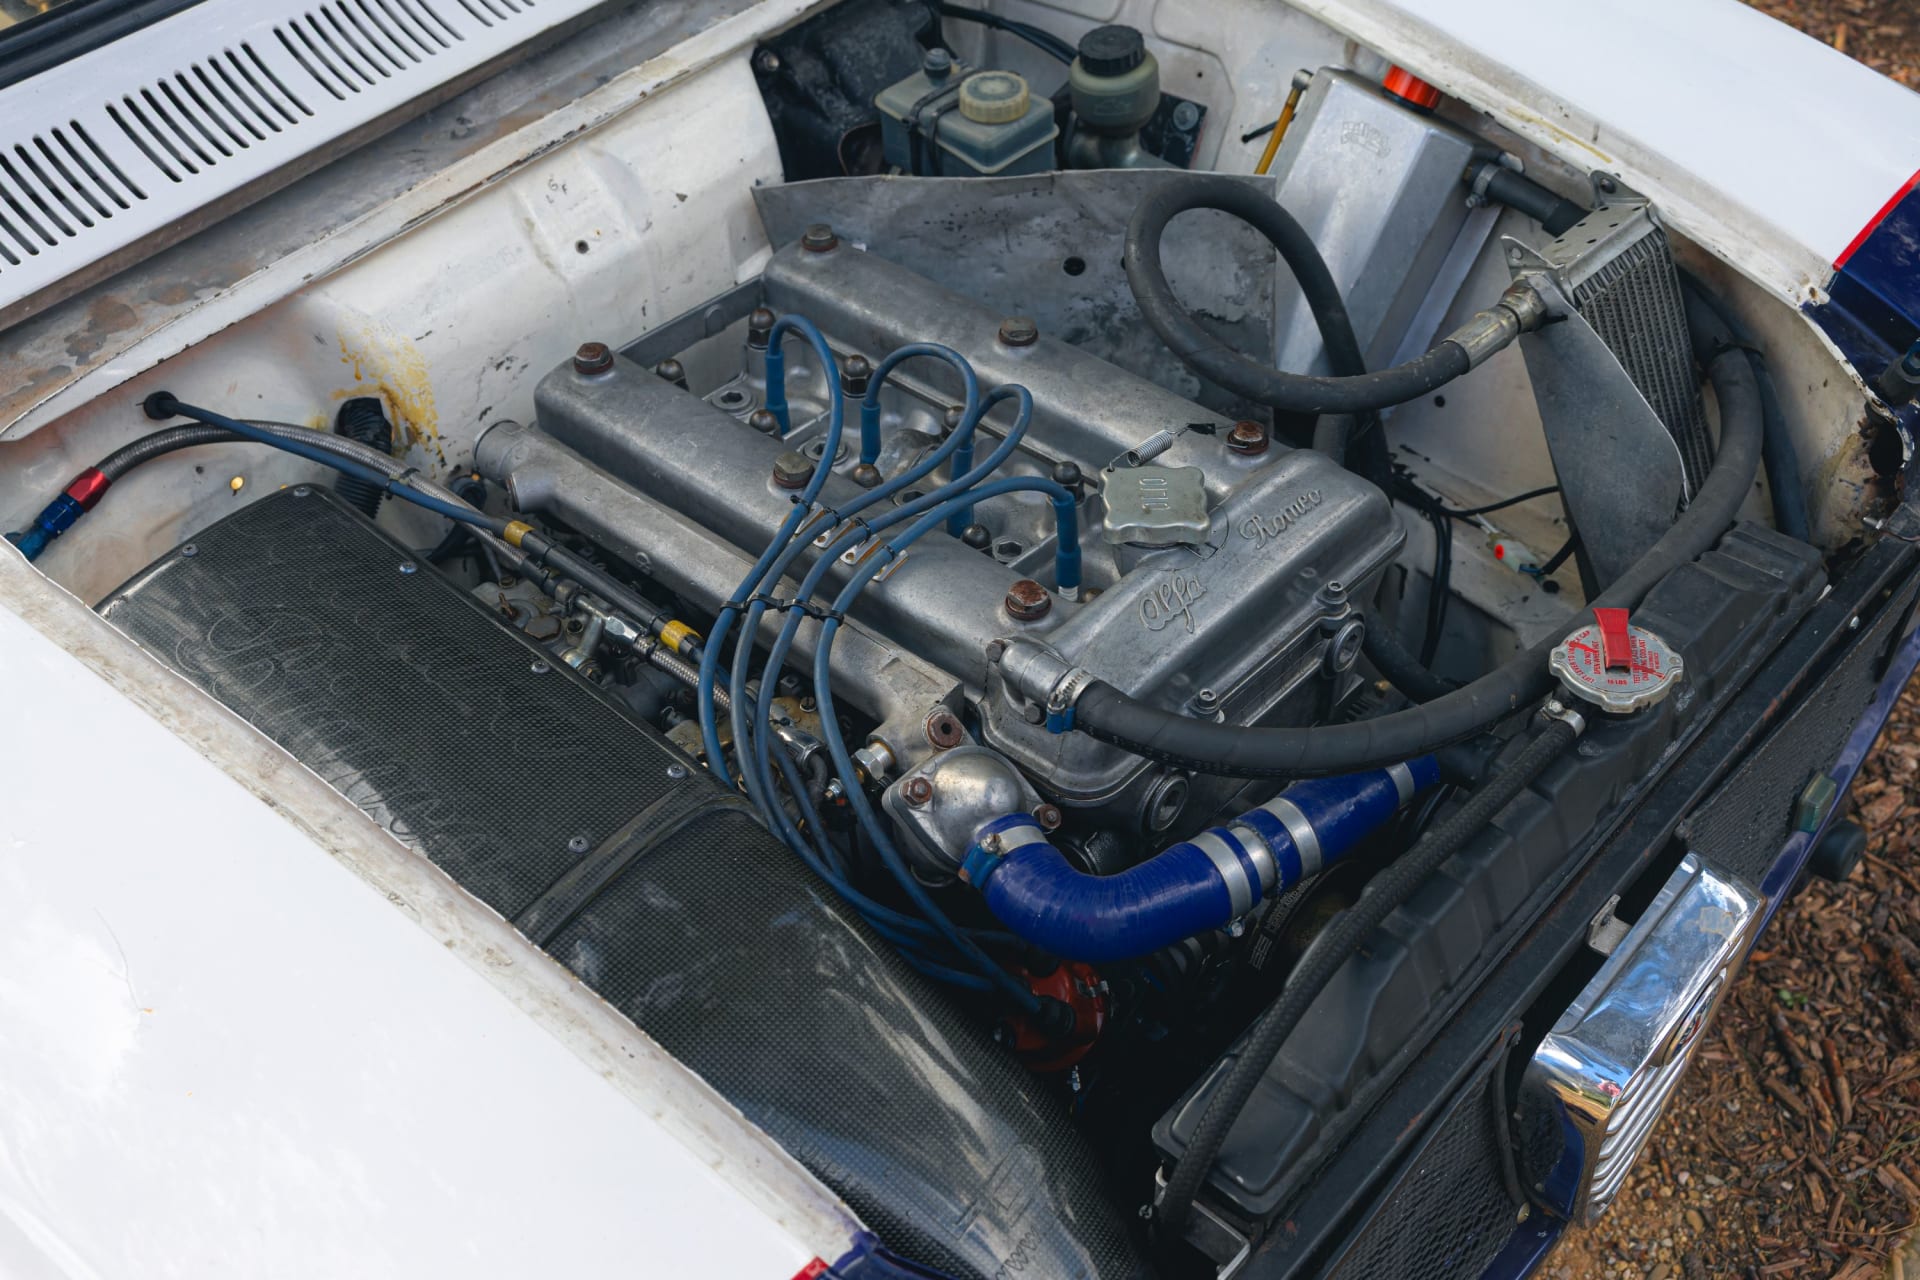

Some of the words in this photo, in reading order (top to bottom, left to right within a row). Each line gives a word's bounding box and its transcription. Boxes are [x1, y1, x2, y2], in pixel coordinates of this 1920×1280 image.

[1139, 478, 1171, 512] OLIO
[1138, 574, 1207, 634] Alfa
[1238, 489, 1322, 549] Romeo
[1591, 640, 1600, 649] HOT
[1639, 639, 1647, 659] COOLANT
[1593, 663, 1601, 675] OPEN
[1633, 674, 1641, 684] TEST
